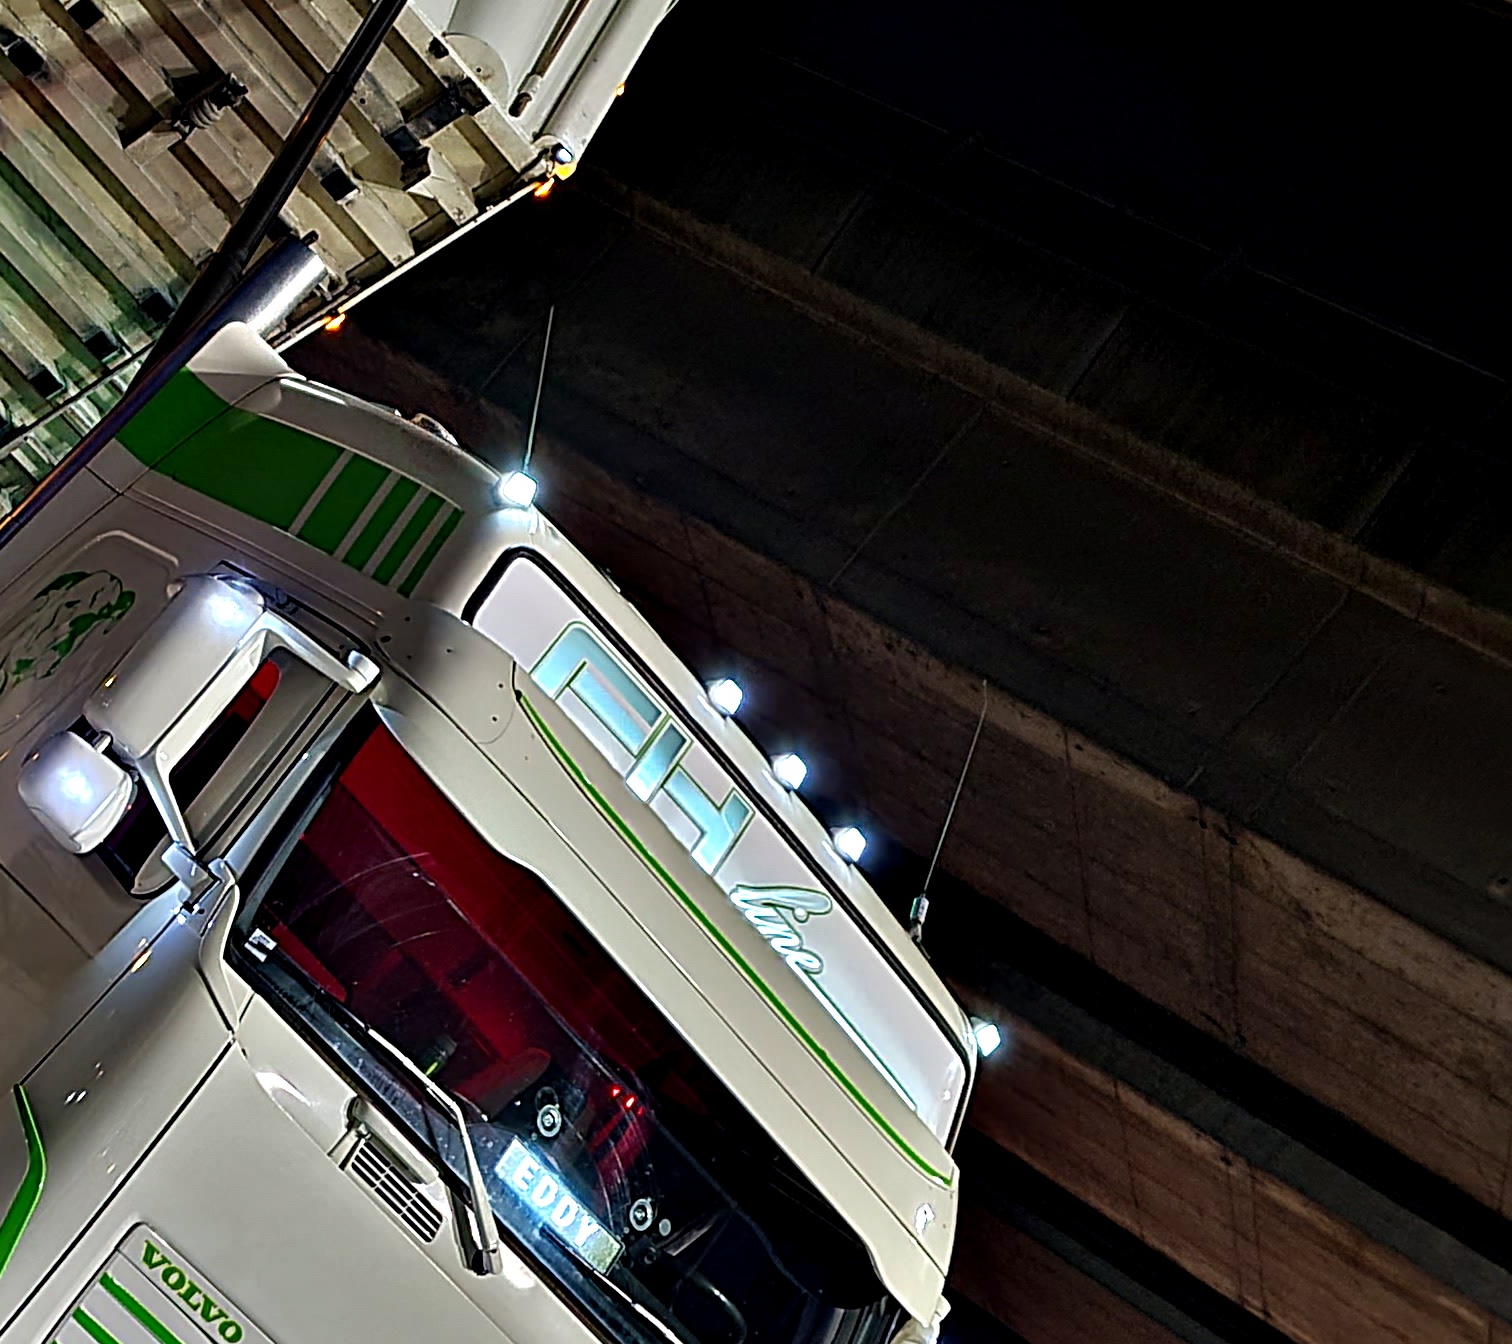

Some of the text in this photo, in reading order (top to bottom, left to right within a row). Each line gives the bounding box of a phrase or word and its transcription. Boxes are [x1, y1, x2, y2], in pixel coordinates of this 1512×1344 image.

[528, 619, 833, 974] FH line
[511, 1154, 603, 1249] EDDY
[142, 1239, 244, 1344] VOLVO
